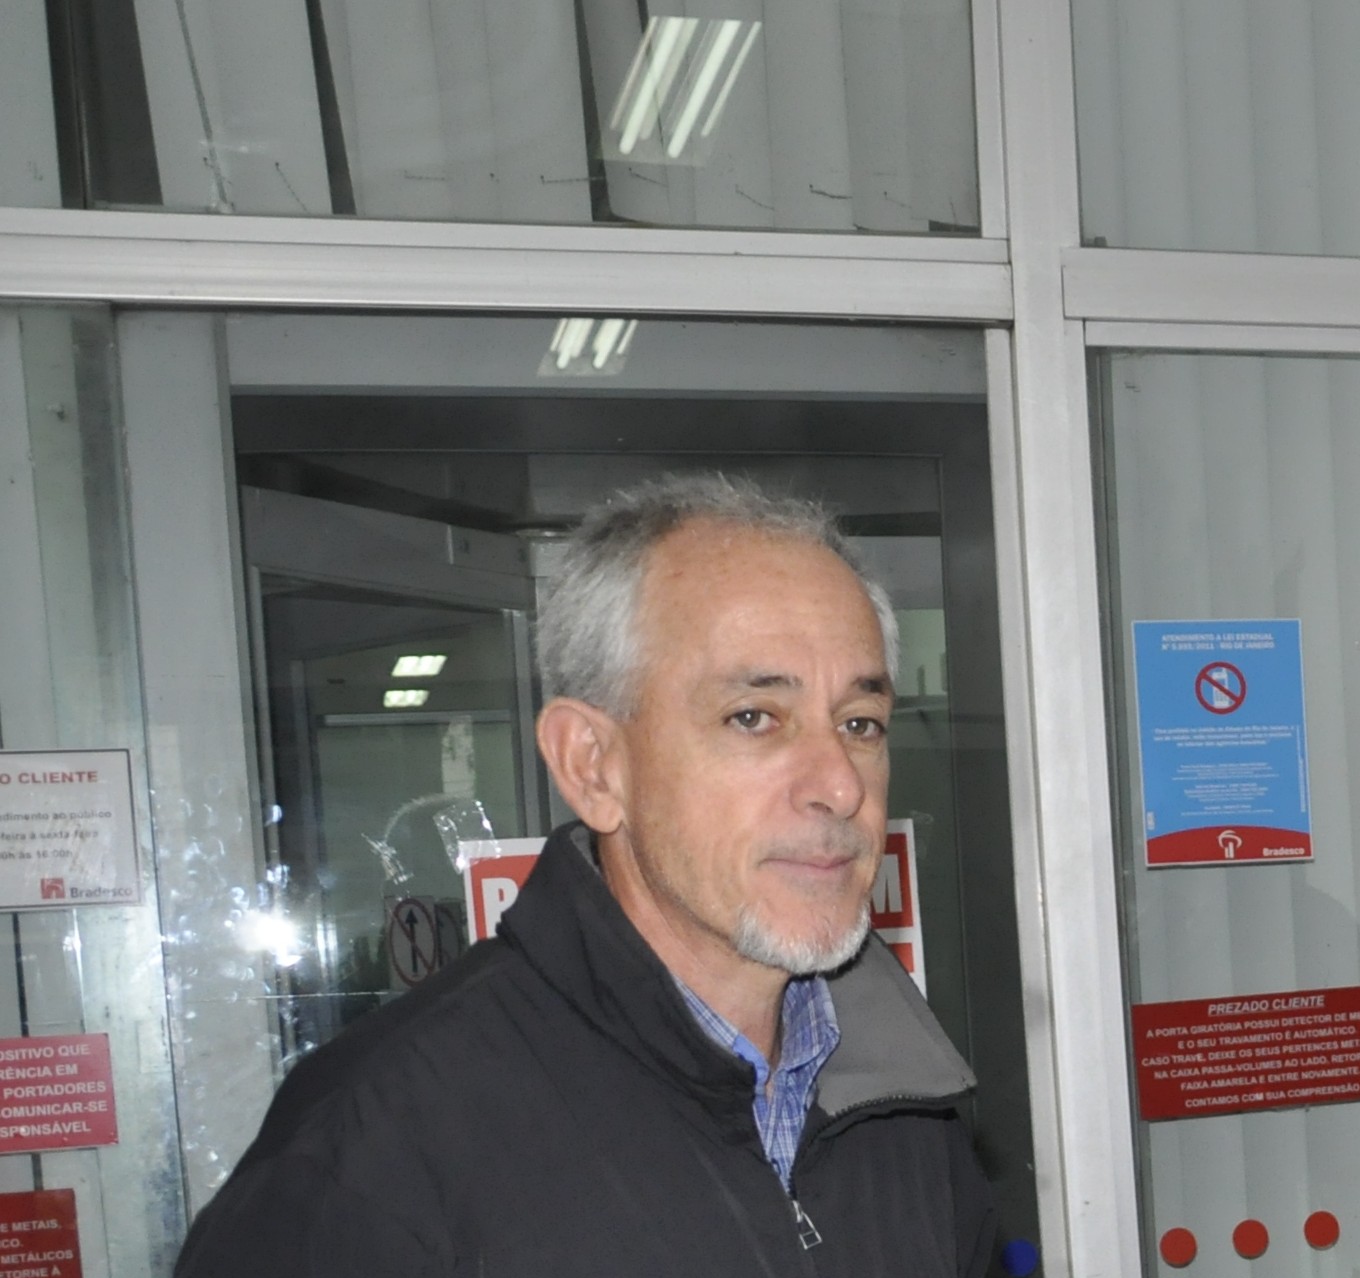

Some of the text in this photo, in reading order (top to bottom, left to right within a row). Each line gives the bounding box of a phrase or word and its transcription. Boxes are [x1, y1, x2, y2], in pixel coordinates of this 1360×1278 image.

[18, 770, 98, 784] CLIENTE
[69, 810, 112, 822] público
[1263, 847, 1305, 857] Bradesco
[70, 887, 132, 898] Bradesco
[1208, 995, 1325, 1016] PREZADO CLIENTE
[1146, 1029, 1154, 1038] A
[1155, 1027, 1188, 1037] PORTA
[1190, 1021, 1242, 1034] GIRATÓRIA
[1245, 1019, 1279, 1030] POSSUI
[1282, 1014, 1332, 1026] DETECTOR
[1334, 1012, 1346, 1021] DE
[1178, 1041, 1185, 1049] E
[1187, 1040, 1195, 1048] O
[1197, 1038, 1216, 1047] SEU
[1218, 1032, 1283, 1046] TRAVAMENTO
[58, 1044, 90, 1057] QUE
[1141, 1057, 1170, 1066] CASO
[1208, 1051, 1236, 1060] DEIXE
[1239, 1049, 1252, 1058] OS
[1255, 1046, 1280, 1056] SEUS
[1282, 1041, 1338, 1053] PERTENCES
[56, 1064, 78, 1076] EM
[1154, 1070, 1168, 1079] NA
[1170, 1068, 1200, 1078] CAIXA
[1202, 1060, 1282, 1075] PASSA-VOLUMES
[1284, 1058, 1298, 1067] AO
[1181, 1080, 1209, 1090] FAIXA
[1211, 1076, 1257, 1088] AMARELA
[1259, 1075, 1265, 1083] E
[1268, 1071, 1298, 1083] ENTRE
[3, 1081, 106, 1099] PORTADORES
[1185, 1083, 1360, 1108] CONTAMOS COM SUA COMPREENSÃO
[1, 1249, 74, 1264] METÁLICOS
